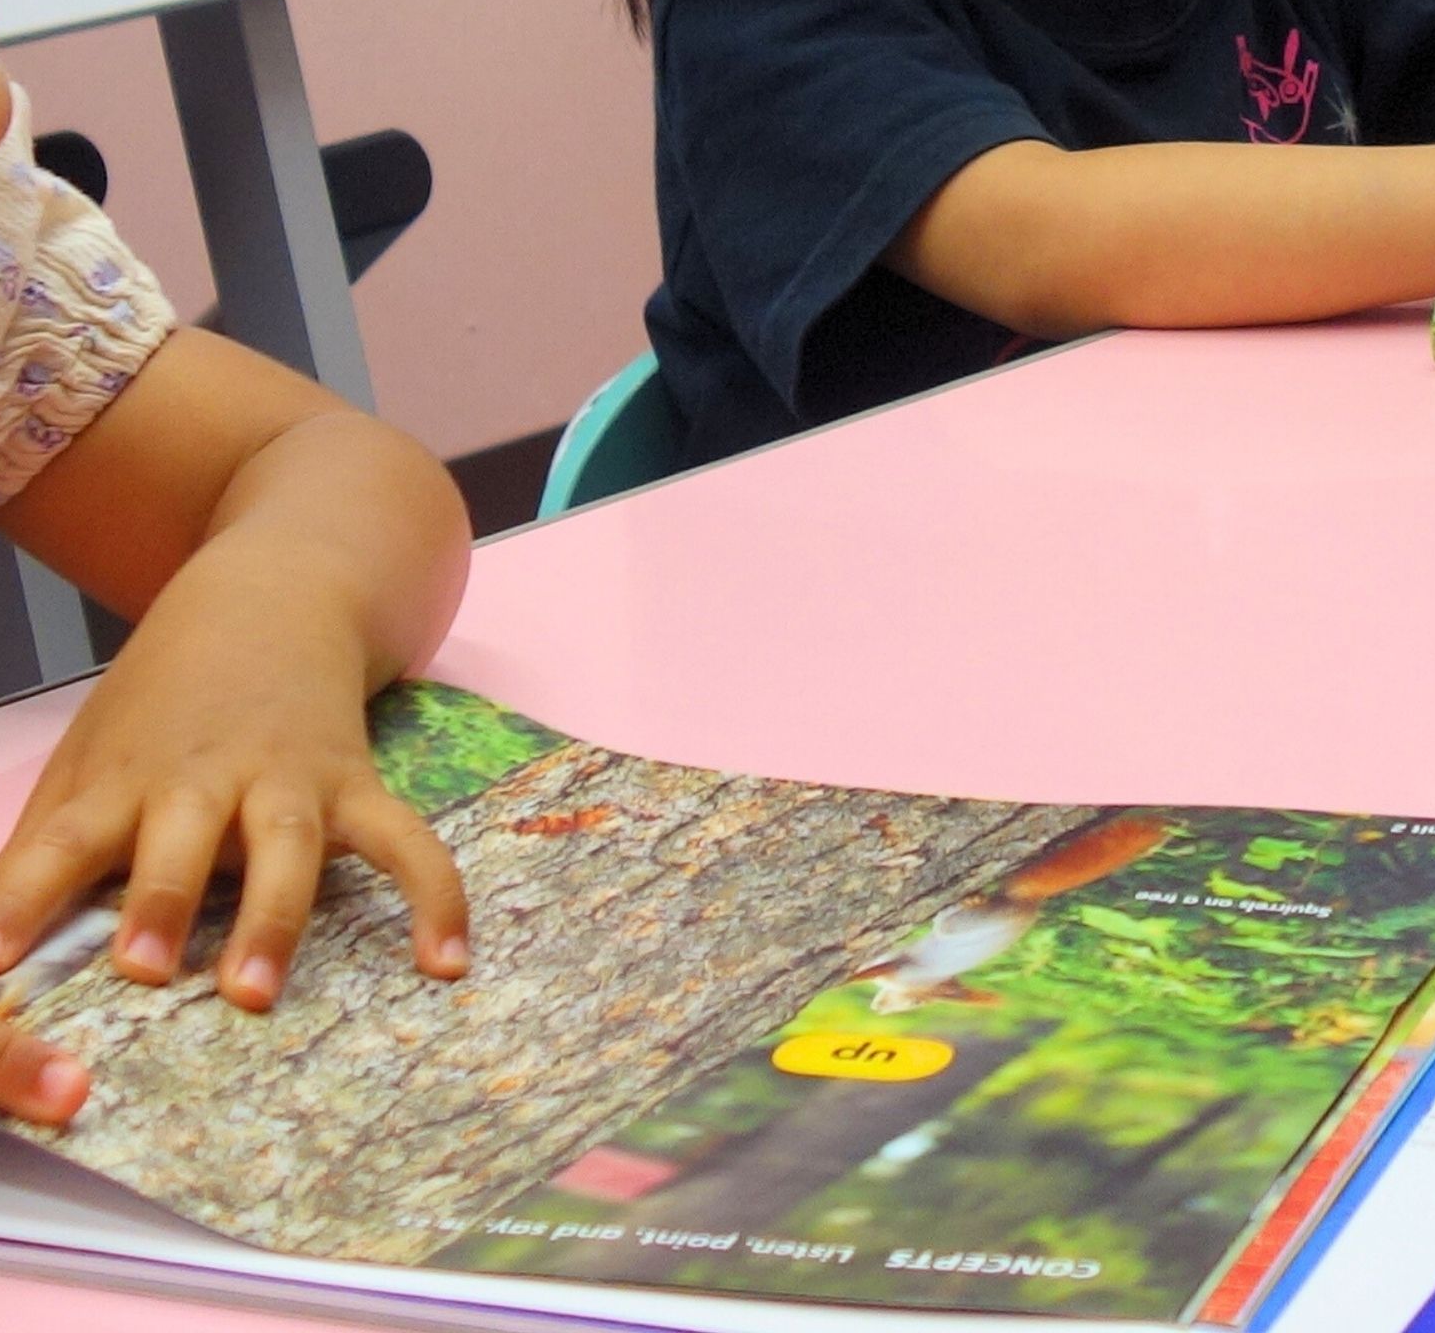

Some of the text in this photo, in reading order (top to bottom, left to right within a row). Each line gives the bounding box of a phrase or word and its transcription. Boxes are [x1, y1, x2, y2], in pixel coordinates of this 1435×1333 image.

[1390, 822, 1408, 834] 2
[1134, 890, 1333, 920] Squirrels on a tree
[831, 1041, 898, 1063] up
[485, 1215, 549, 1237] say.
[549, 1221, 624, 1242] and
[635, 1228, 740, 1252] point,
[745, 1238, 857, 1265] Listen,
[885, 1248, 1102, 1280] CONCEPTS
